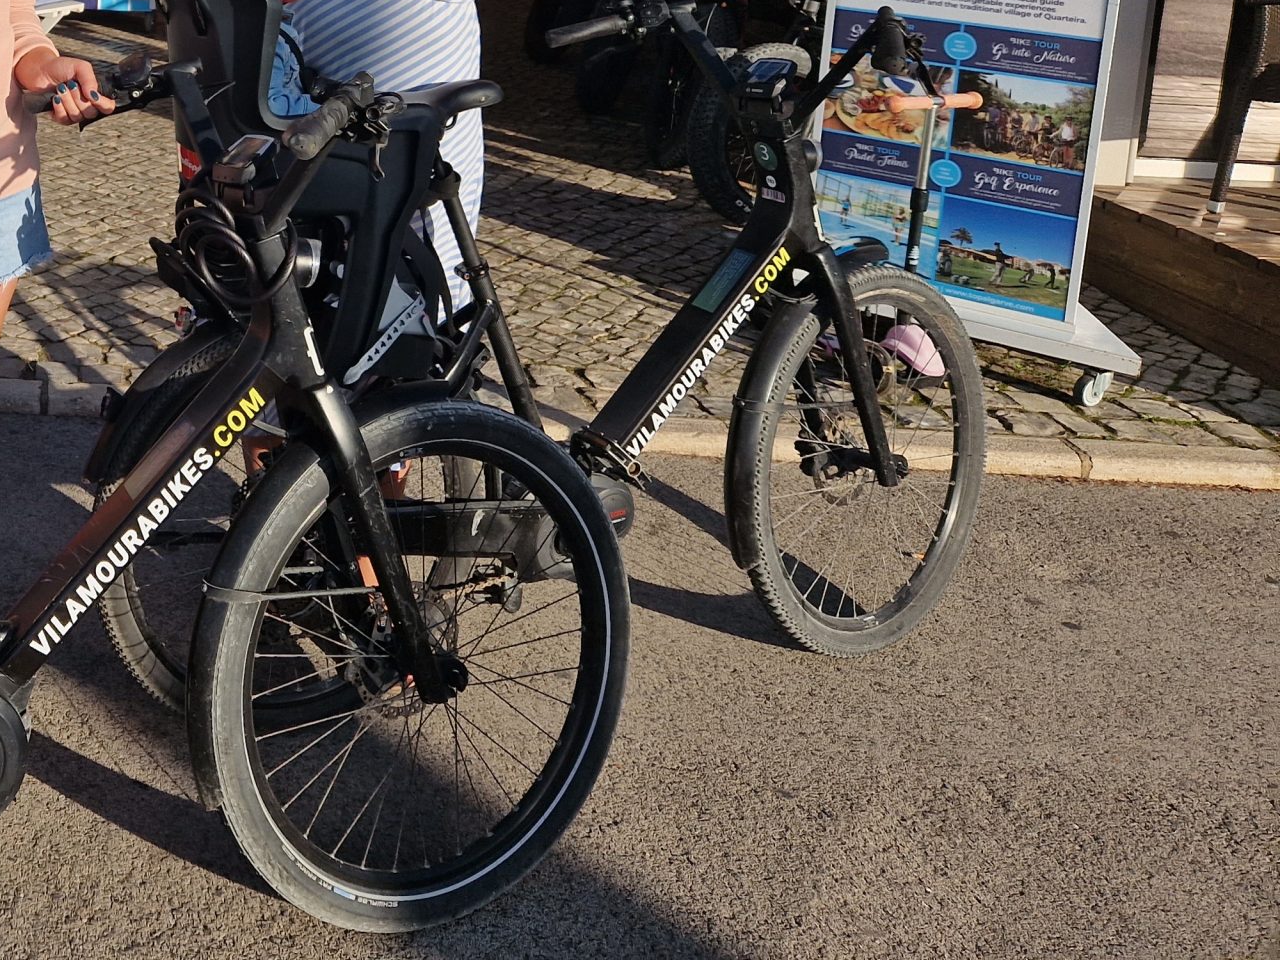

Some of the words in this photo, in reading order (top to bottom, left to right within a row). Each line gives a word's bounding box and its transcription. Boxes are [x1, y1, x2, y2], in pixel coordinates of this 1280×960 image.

[960, 2, 1002, 14] traditional
[1003, 8, 1032, 18] village
[1043, 12, 1087, 24] Quarteira.
[1004, 1, 1057, 13] experiences
[1009, 37, 1031, 46] BIKE
[1033, 39, 1061, 50] TOUR
[1011, 46, 1031, 58] into
[1033, 49, 1077, 64] Nature
[760, 144, 769, 161] 3
[876, 146, 901, 156] TOUR
[1016, 171, 1043, 182] TOUR
[1003, 176, 1060, 197] Experience
[626, 246, 792, 458] VILAMOURABIKES.COM
[28, 387, 266, 656] VILAMOURABIKES.COM
